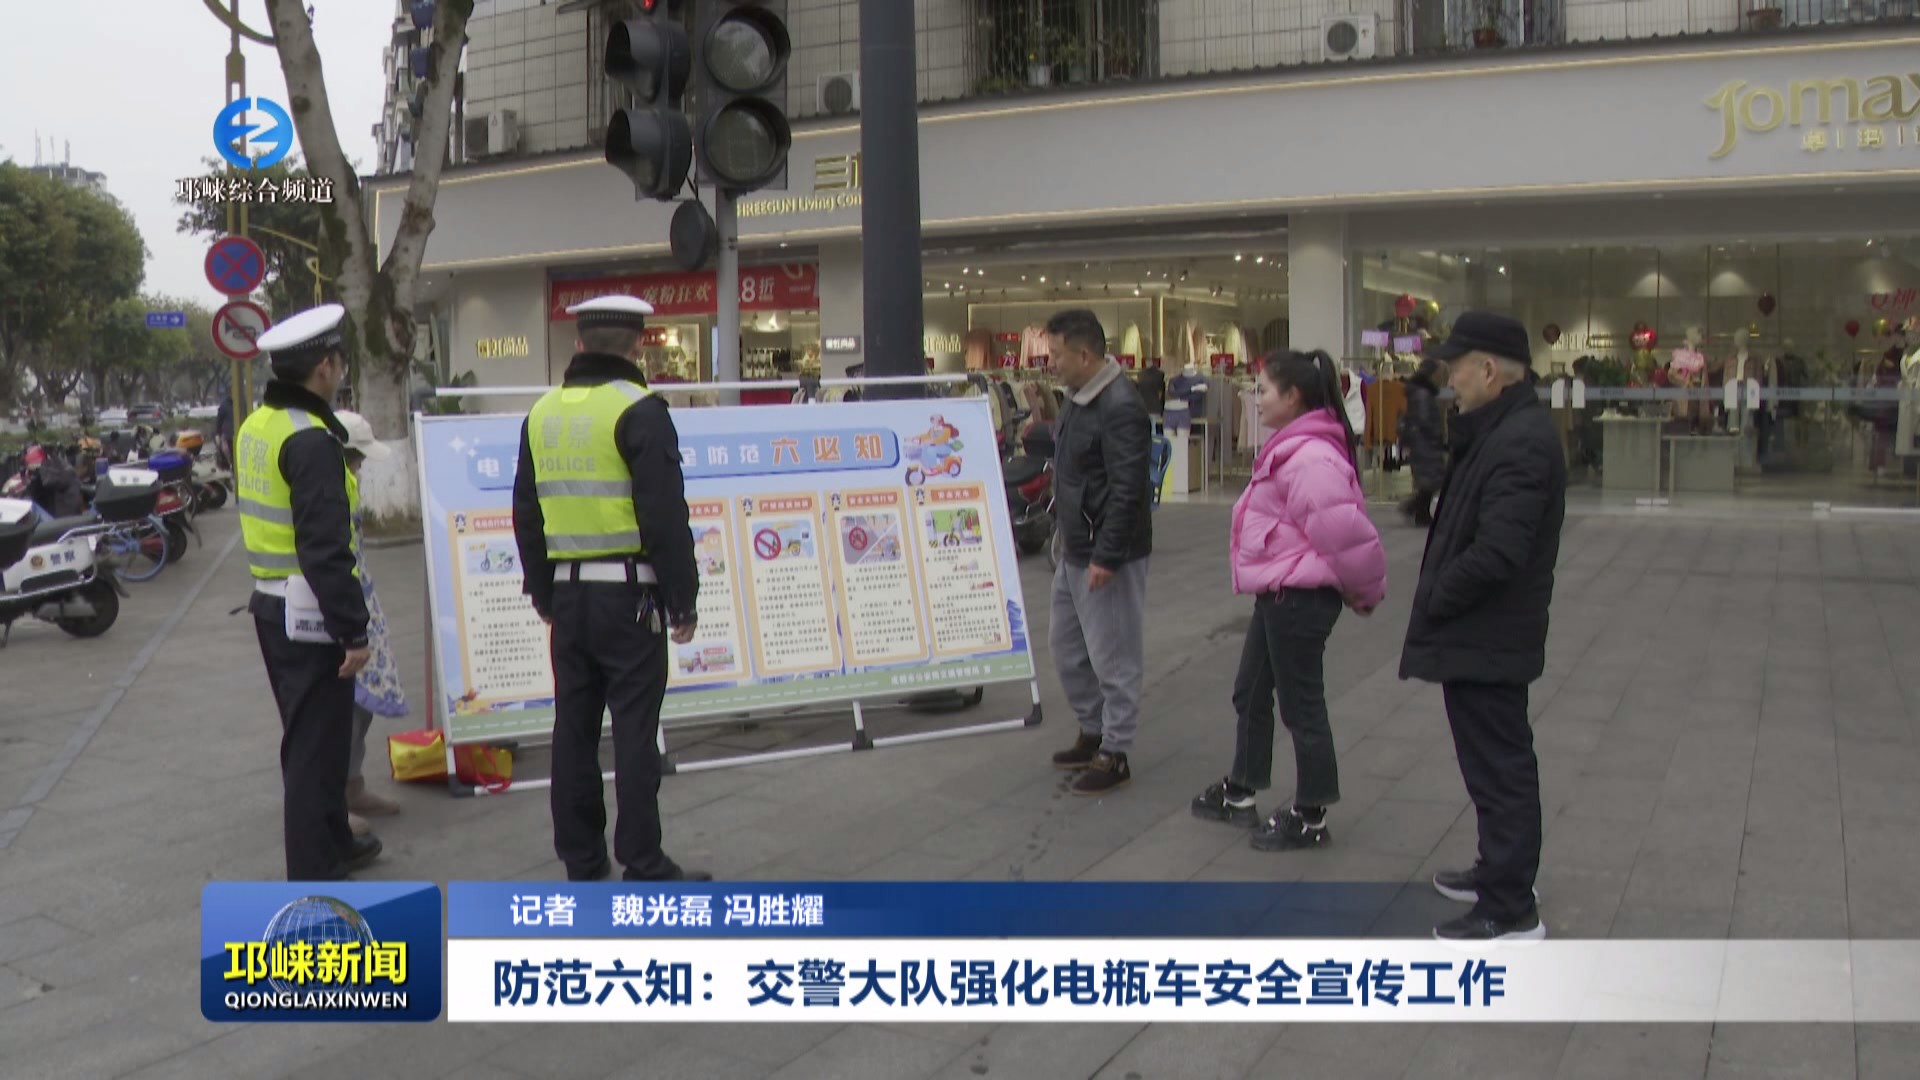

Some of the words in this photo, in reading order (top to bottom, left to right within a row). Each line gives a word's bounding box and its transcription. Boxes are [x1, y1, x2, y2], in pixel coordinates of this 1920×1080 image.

[736, 198, 795, 217] HREEGUN
[797, 195, 834, 213] Living
[542, 415, 593, 449] 警察
[539, 456, 597, 472] POLICE
[238, 472, 271, 496] OLICE
[50, 550, 76, 567] 警察
